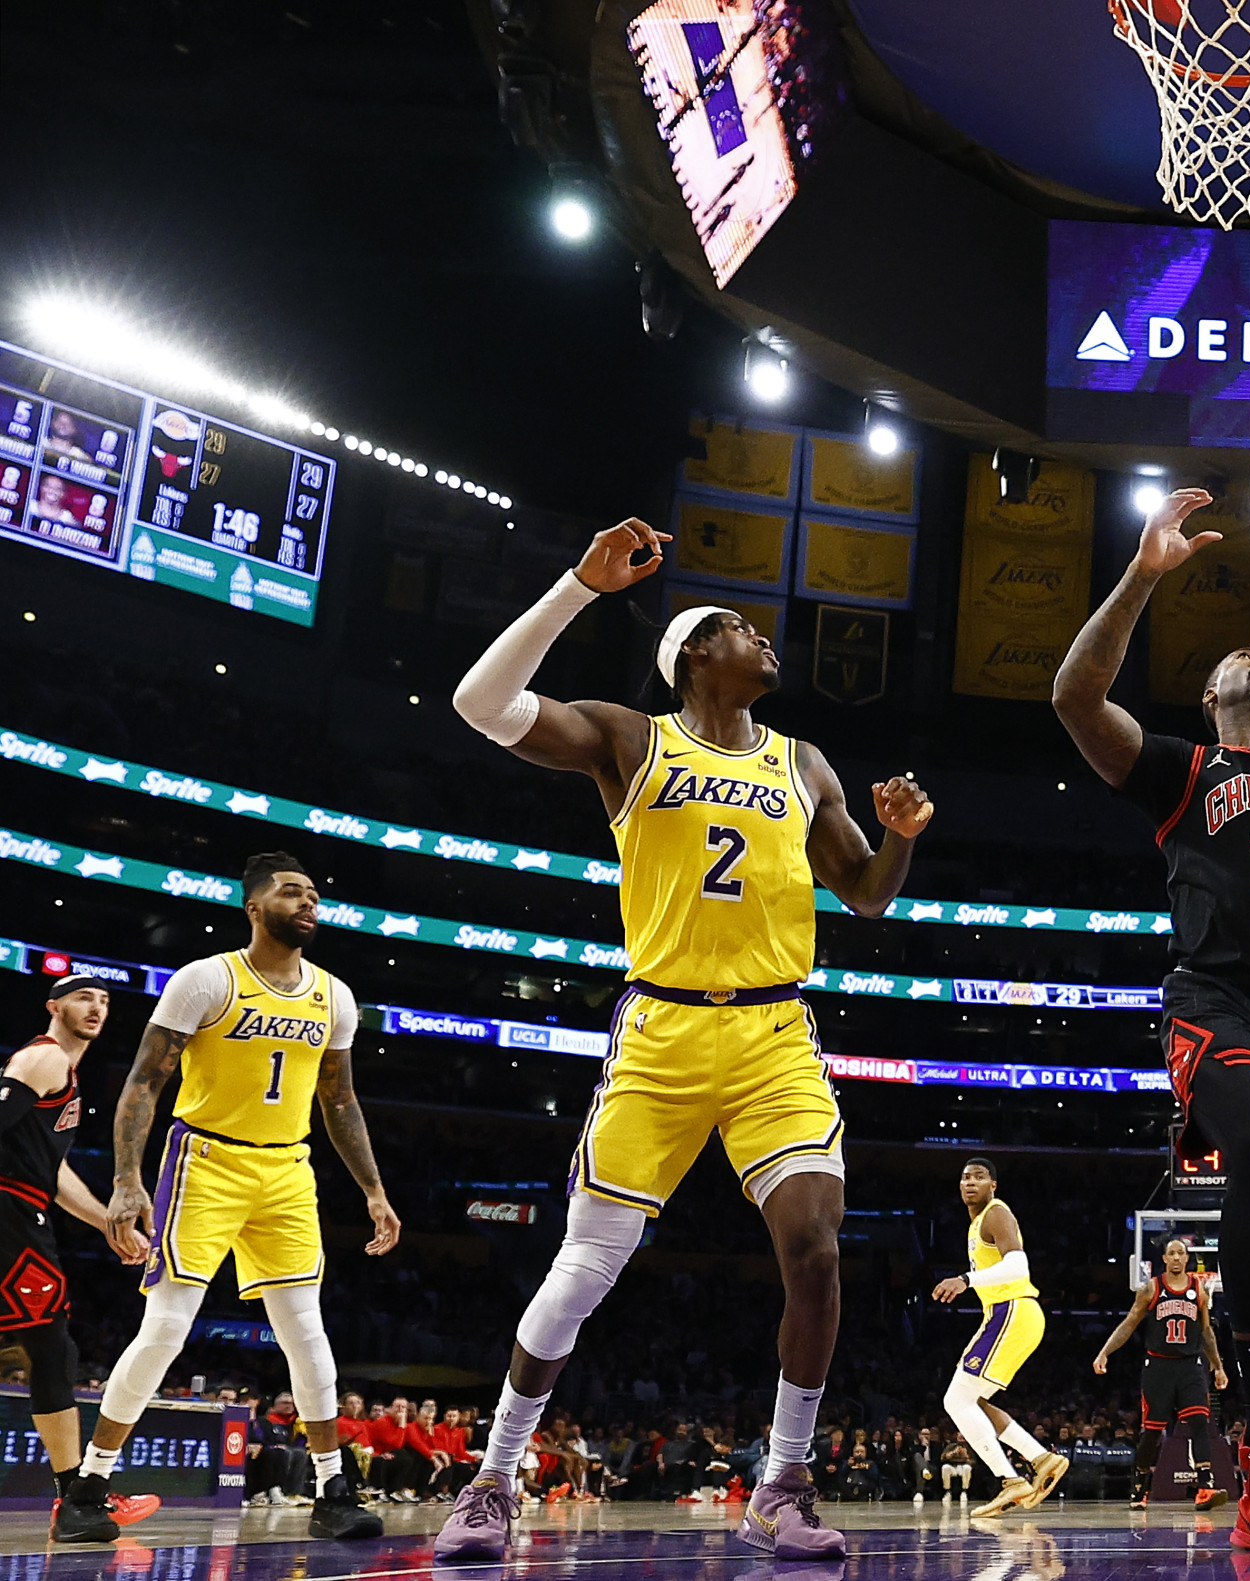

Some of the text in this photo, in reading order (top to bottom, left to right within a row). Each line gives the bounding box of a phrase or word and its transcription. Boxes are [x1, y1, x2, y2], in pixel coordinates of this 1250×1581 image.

[14, 400, 33, 424] 5
[204, 429, 226, 455] 29
[199, 461, 221, 486] 27
[300, 462, 324, 490] 29
[296, 494, 319, 520] 27
[213, 502, 261, 542] 1:46
[0, 731, 68, 769] Sprite
[757, 763, 786, 778] bibigo
[140, 770, 213, 803] Sprite
[647, 766, 790, 821] LAKERS
[304, 809, 369, 839] Sprite
[0, 831, 62, 866] Sprite
[434, 835, 499, 859] Sprite
[582, 861, 623, 884] Spri
[701, 823, 747, 902] 2
[161, 870, 233, 901] Sprite
[316, 904, 365, 928] prite
[954, 904, 1010, 925] Sprite
[1086, 911, 1141, 933] Sprite
[454, 925, 518, 949] Sprite
[580, 944, 633, 967] Sprit
[71, 961, 129, 982] TOYOTA
[838, 972, 894, 994] Sprite
[984, 989, 992, 1000] 1
[1056, 987, 1081, 1004] 29
[1107, 993, 1147, 1004] Lakers
[223, 1006, 327, 1048] LAKERS
[399, 1010, 486, 1038] Spectrum
[512, 1030, 601, 1051] UCLA Health
[263, 1050, 286, 1105] 1
[967, 1067, 1008, 1082] ULTRA
[1041, 1072, 1103, 1086] DELTA
[1190, 1175, 1228, 1185] TISSOT
[467, 1201, 519, 1221] Coca-Cola
[1156, 1300, 1198, 1321] CHICAGO
[1166, 1319, 1187, 1343] 11
[130, 1436, 210, 1468] DELTA
[218, 1474, 246, 1487] TOYOTA
